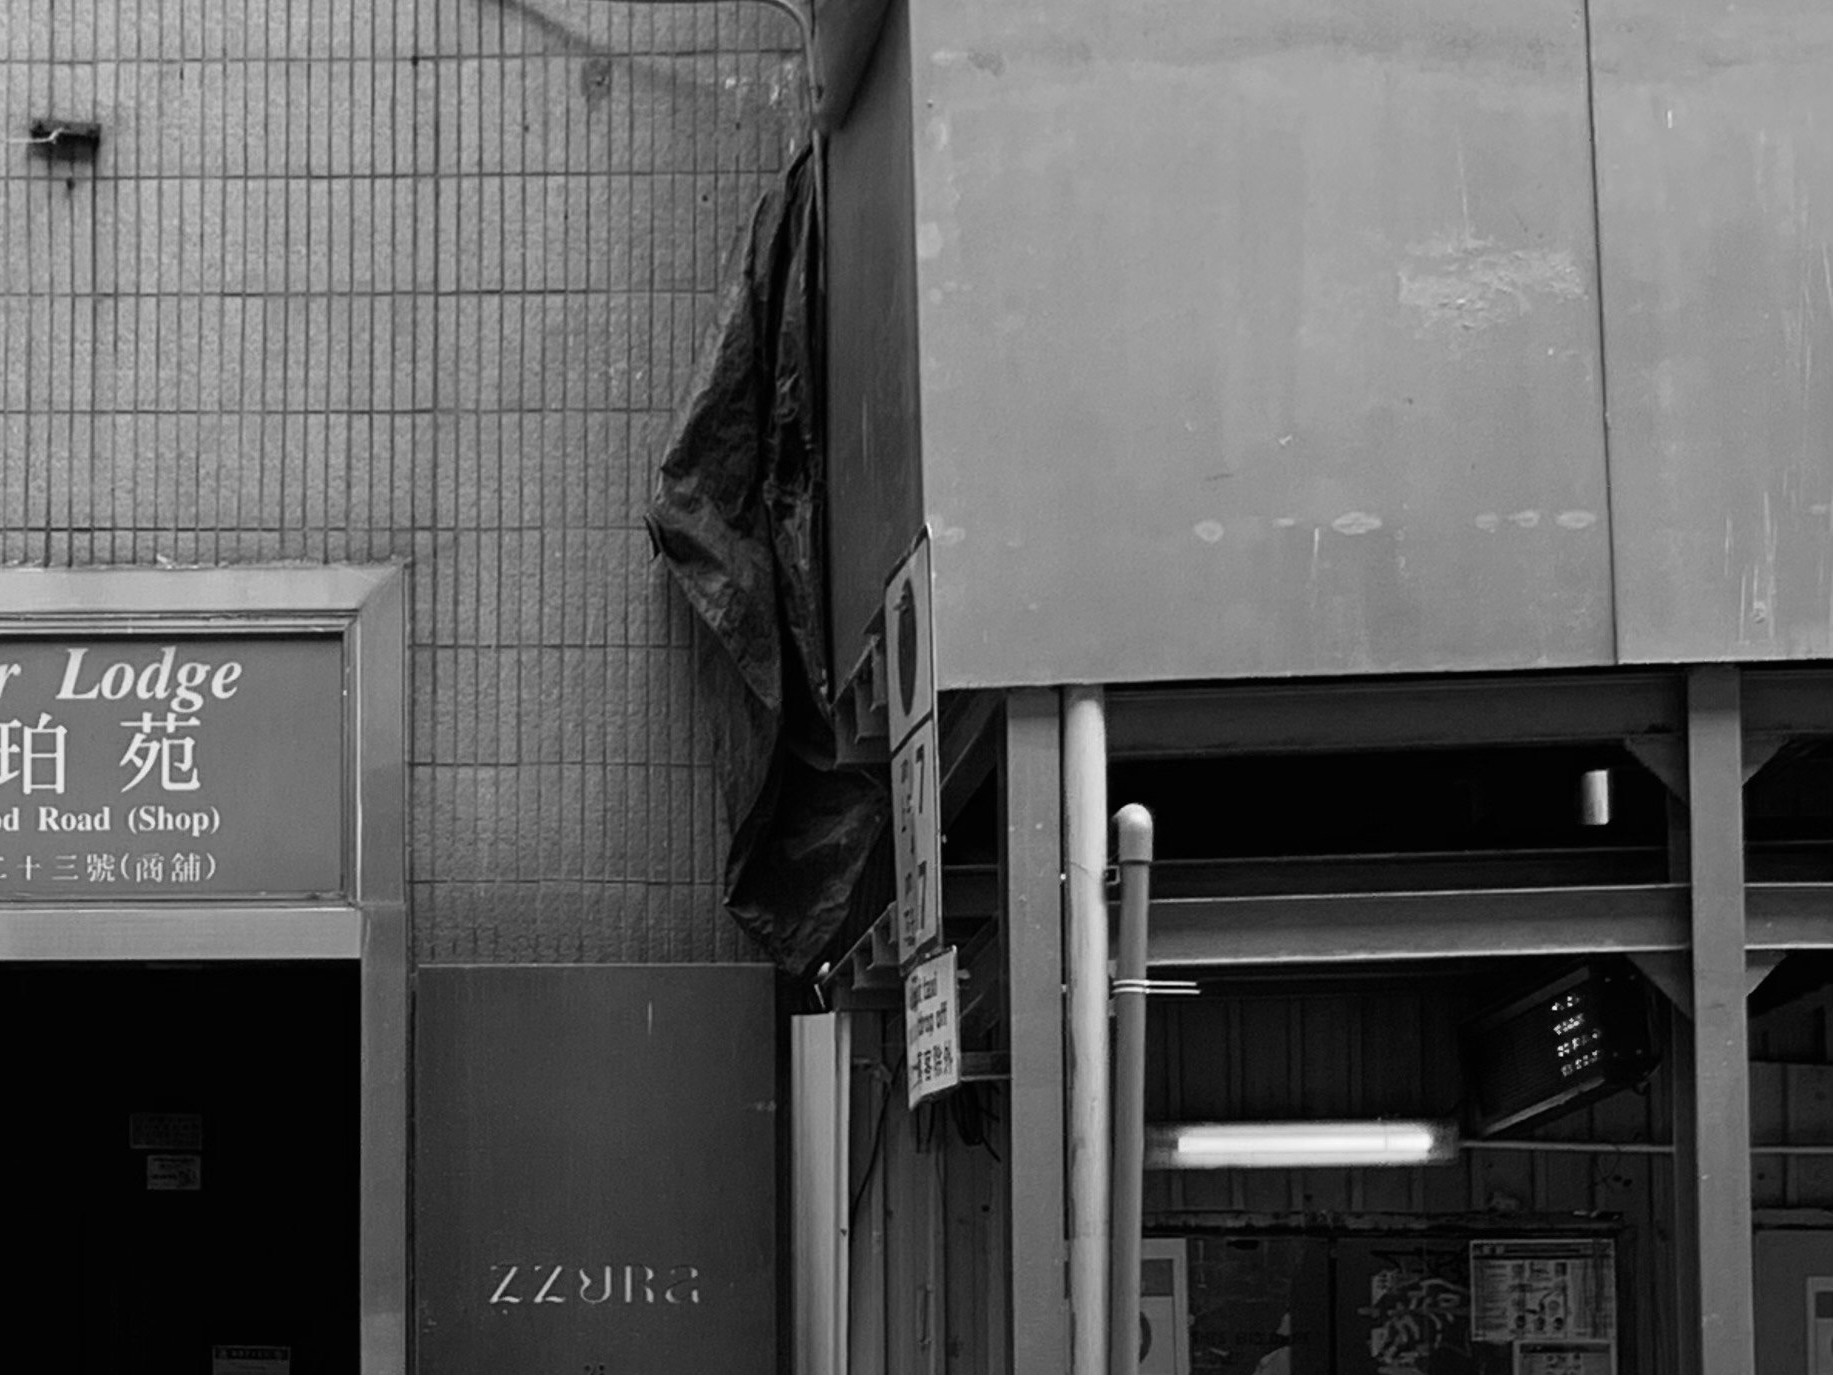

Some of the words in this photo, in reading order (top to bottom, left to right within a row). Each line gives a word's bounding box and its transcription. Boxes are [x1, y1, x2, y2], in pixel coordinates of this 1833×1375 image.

[56, 646, 243, 712] Lodge
[38, 805, 111, 833] Road
[128, 805, 221, 837] (Shop)
